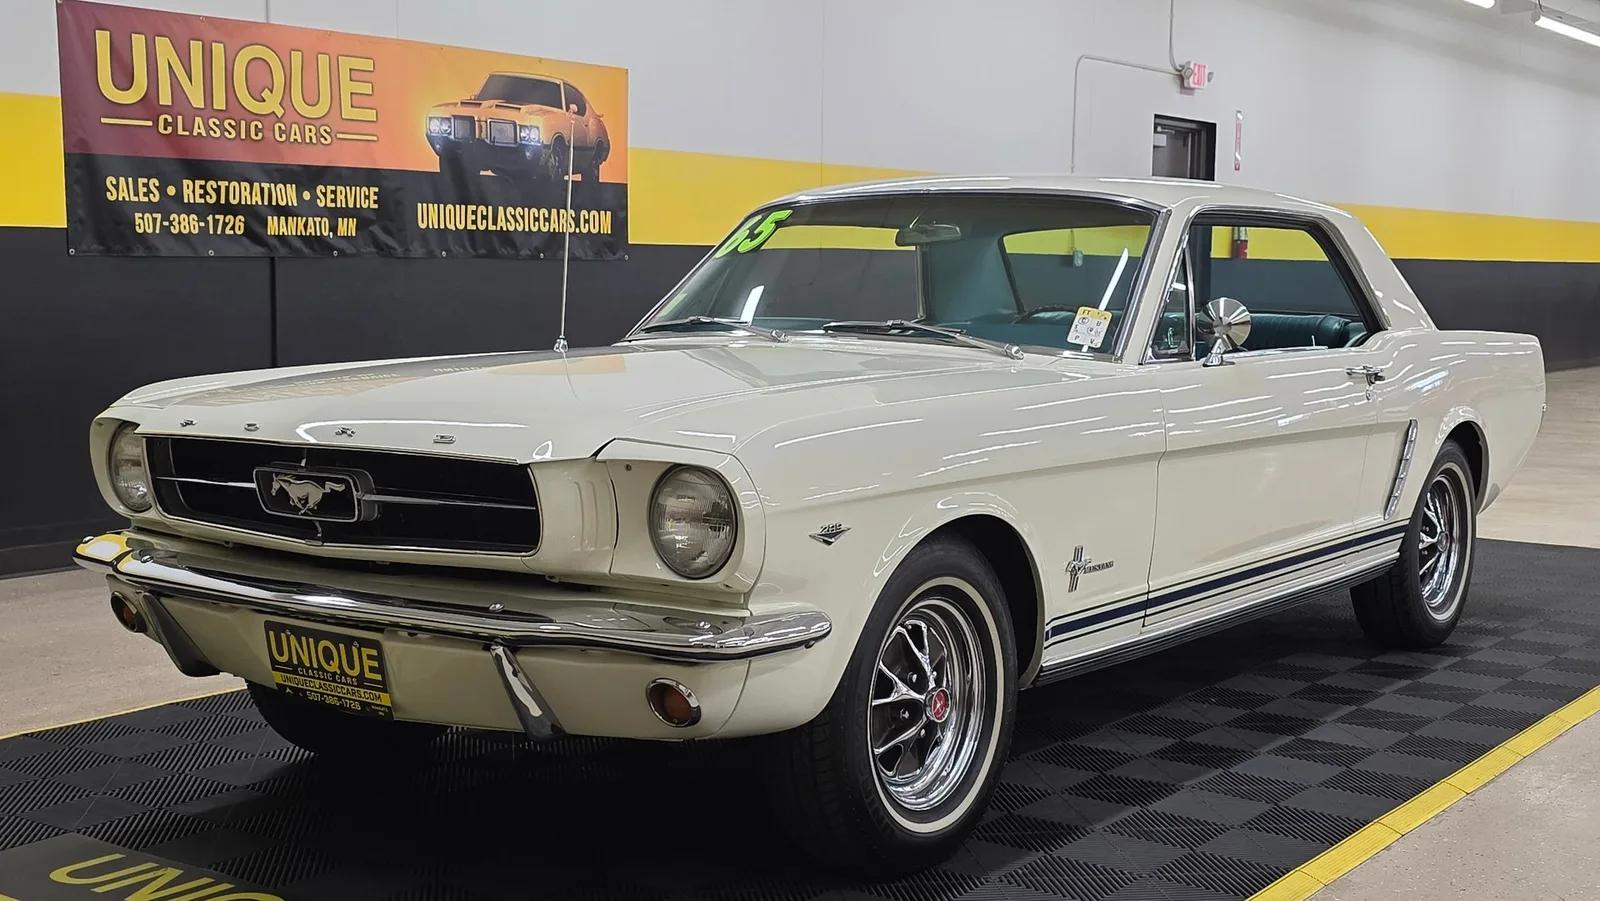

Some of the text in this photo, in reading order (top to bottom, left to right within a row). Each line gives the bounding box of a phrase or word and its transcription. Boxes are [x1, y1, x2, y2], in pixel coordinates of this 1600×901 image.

[95, 29, 377, 122] UNIQUE
[1193, 63, 1206, 86] EXIT
[158, 113, 332, 145] CLASSIC CARS
[105, 175, 379, 209] SALES RESTORATION SERVICE
[134, 212, 357, 239] 507-386-1726 MANKATO, MN
[416, 202, 612, 235] UNIQUECLASSICCARS.COM
[714, 209, 793, 258] 65
[268, 629, 383, 681] UNIQUE
[280, 673, 383, 703] UNIQUECLASSICCARS.COM
[297, 667, 358, 686] CLASSIC CARS
[49, 853, 285, 901] UNI
